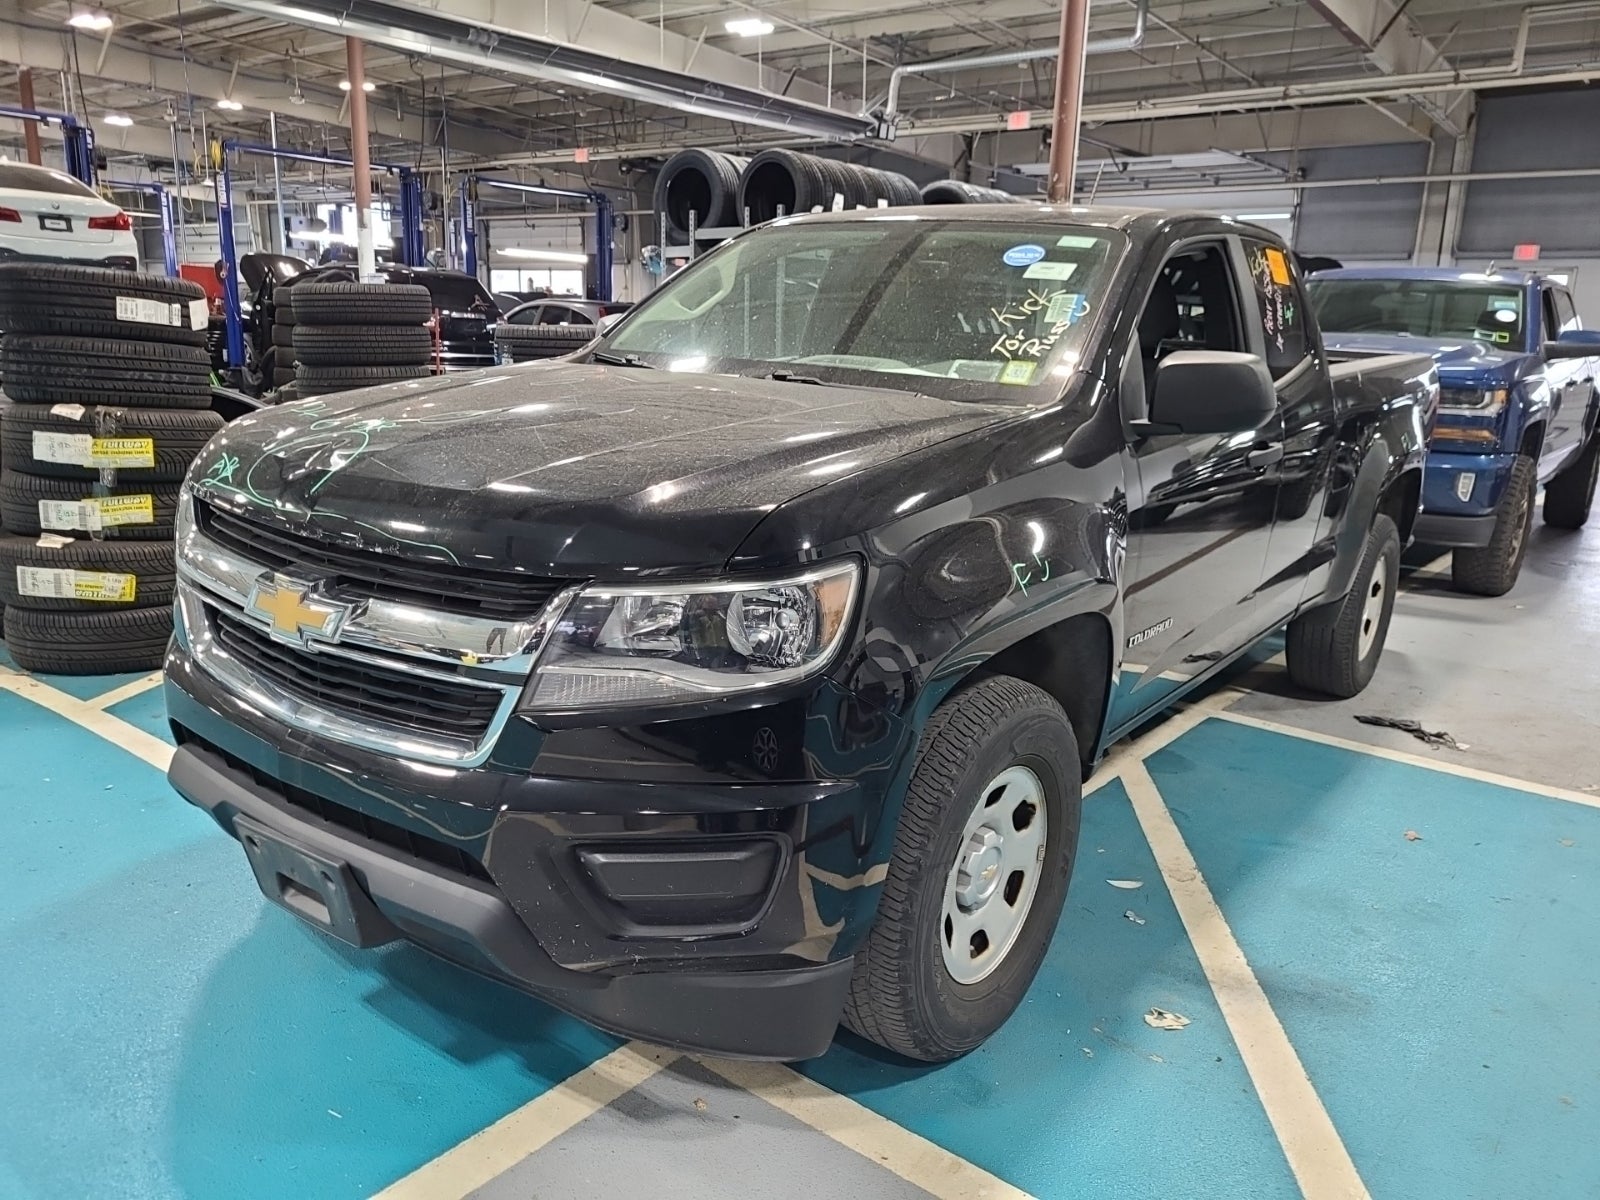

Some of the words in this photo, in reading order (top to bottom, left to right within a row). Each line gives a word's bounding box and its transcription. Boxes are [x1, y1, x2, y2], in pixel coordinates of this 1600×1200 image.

[102, 441, 149, 450] FULLWAY
[102, 496, 148, 507] FULLWAY
[1127, 617, 1174, 649] COLORADO
